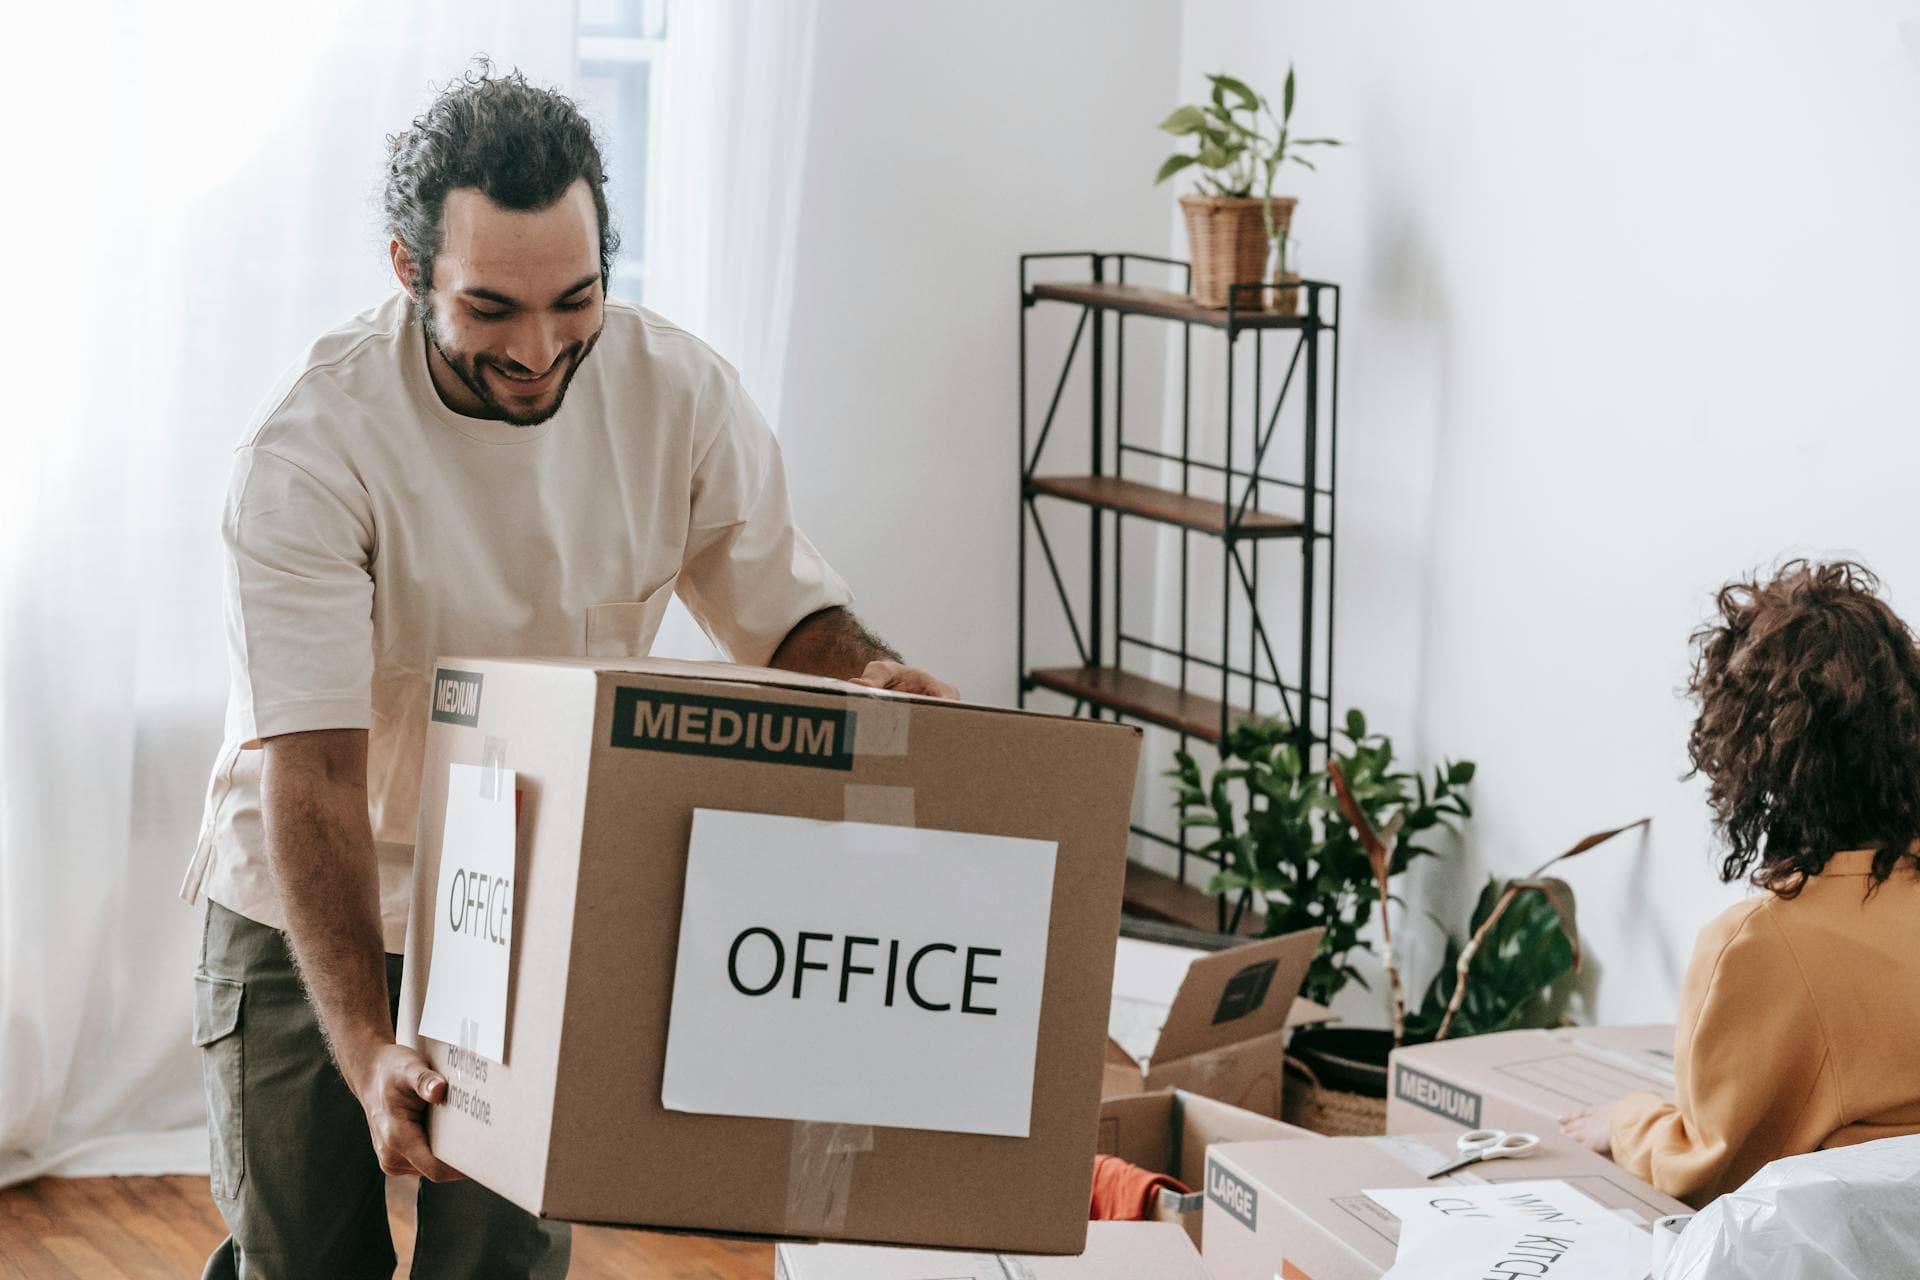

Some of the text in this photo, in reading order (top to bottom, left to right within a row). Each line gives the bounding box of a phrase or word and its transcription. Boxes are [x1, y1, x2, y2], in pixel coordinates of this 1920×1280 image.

[436, 679, 479, 716] MEDIUM
[632, 700, 837, 757] MEDIUM
[450, 868, 509, 946] OFFICE
[728, 926, 1002, 1016] OFFICE
[1400, 1070, 1476, 1122] MEDIUM
[1211, 1167, 1253, 1220] LARGE
